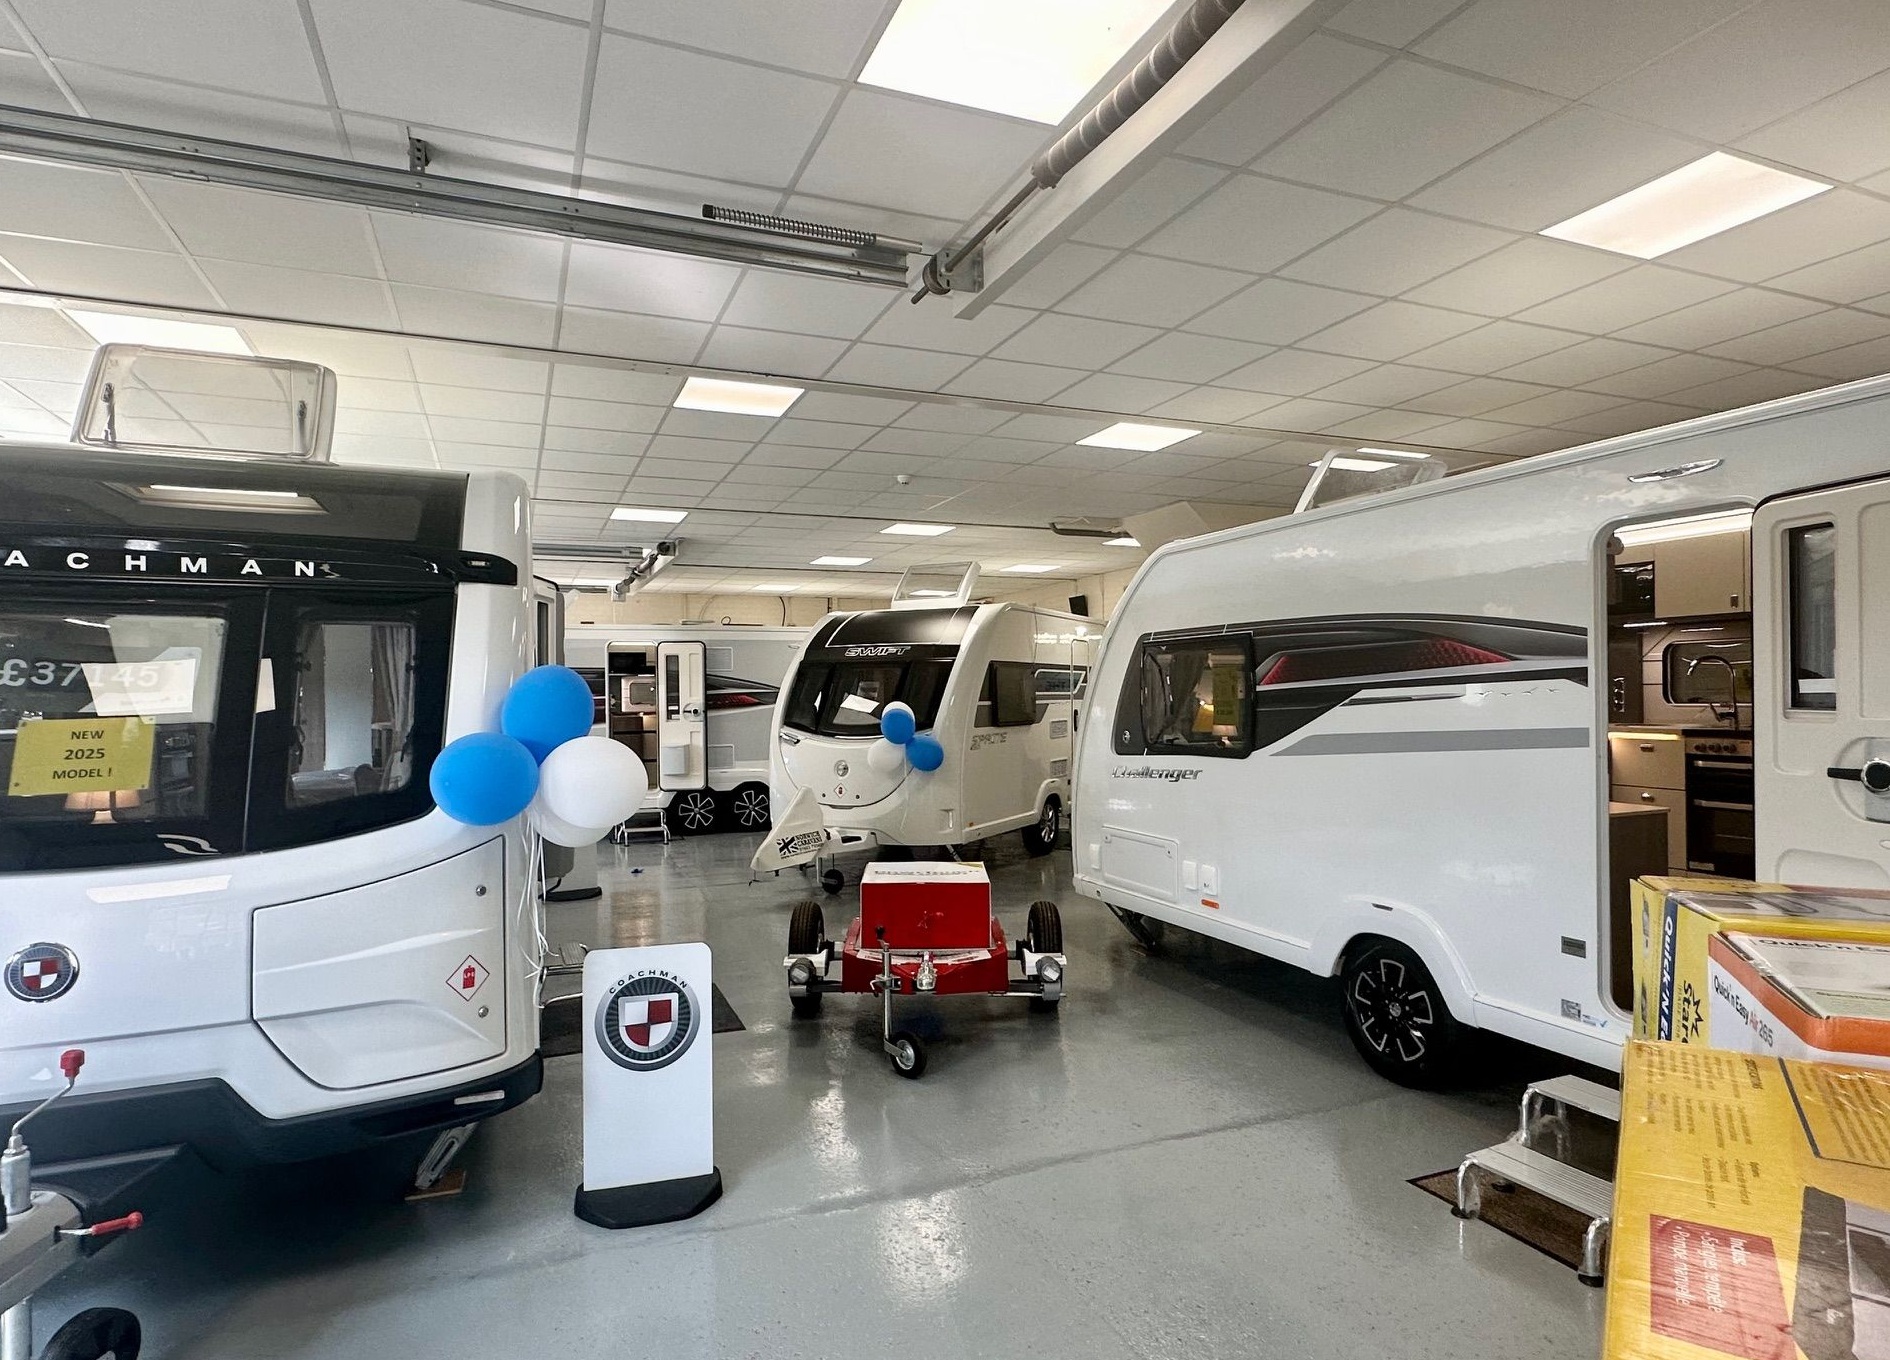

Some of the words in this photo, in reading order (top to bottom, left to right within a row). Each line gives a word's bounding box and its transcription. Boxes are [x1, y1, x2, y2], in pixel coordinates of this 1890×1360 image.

[4, 550, 315, 577] ACHMAN
[844, 646, 911, 657] SWIFT
[71, 730, 105, 740] NEW
[63, 748, 105, 760] 2025
[52, 768, 102, 780] MODEL
[107, 767, 112, 777] !
[1112, 766, 1203, 782] Challenger
[609, 970, 687, 994] COACHMAN
[1735, 995, 1750, 1025] Easy
[1758, 1020, 1774, 1047] 265
[1668, 1231, 1690, 1260] Pompe
